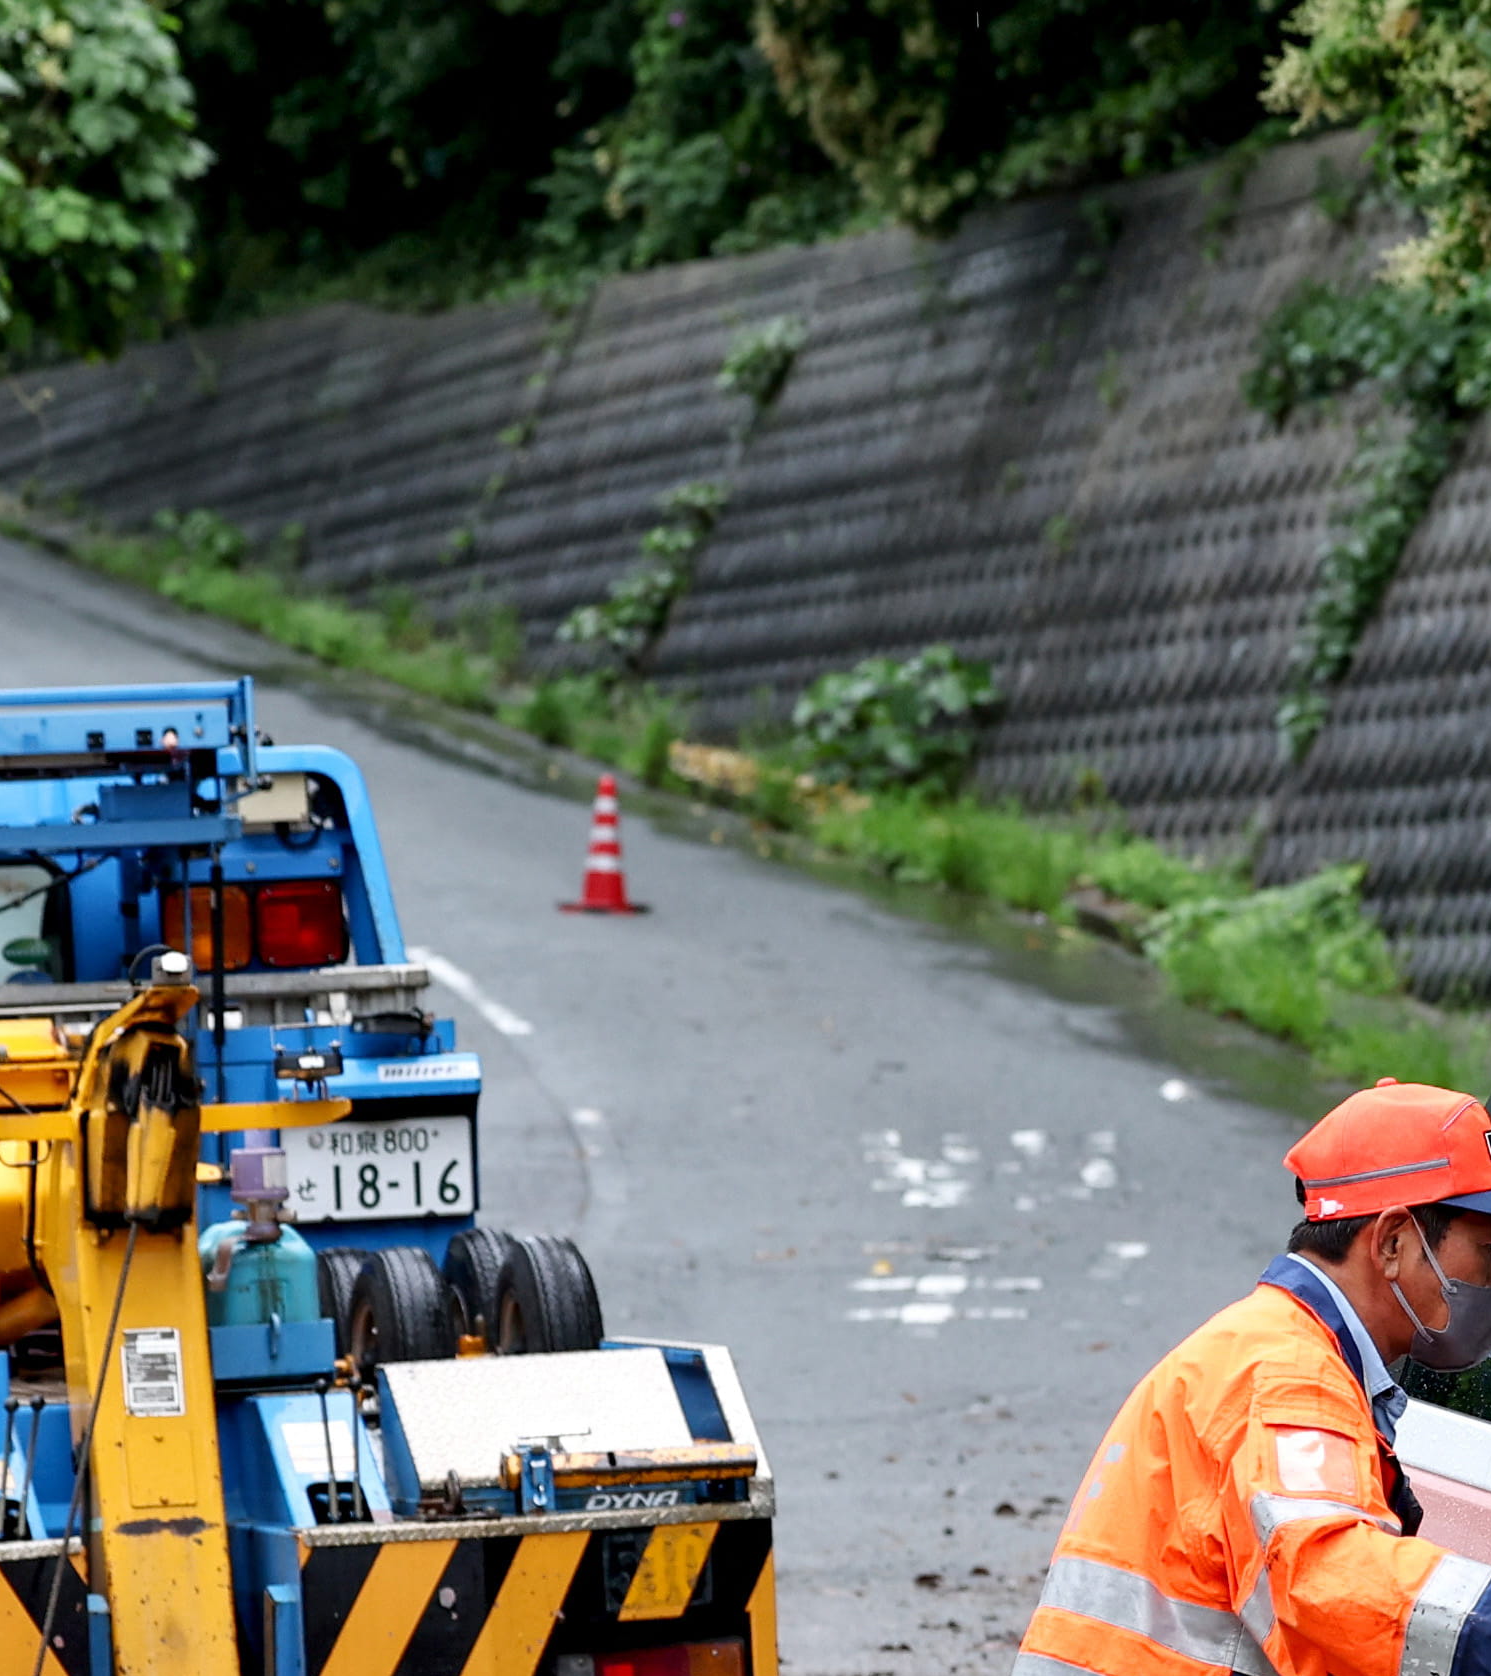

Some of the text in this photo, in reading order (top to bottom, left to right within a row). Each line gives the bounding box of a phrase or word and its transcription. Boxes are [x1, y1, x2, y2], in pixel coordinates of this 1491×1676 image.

[296, 1159, 461, 1211] せ 18-16
[585, 1489, 679, 1511] DYNA
